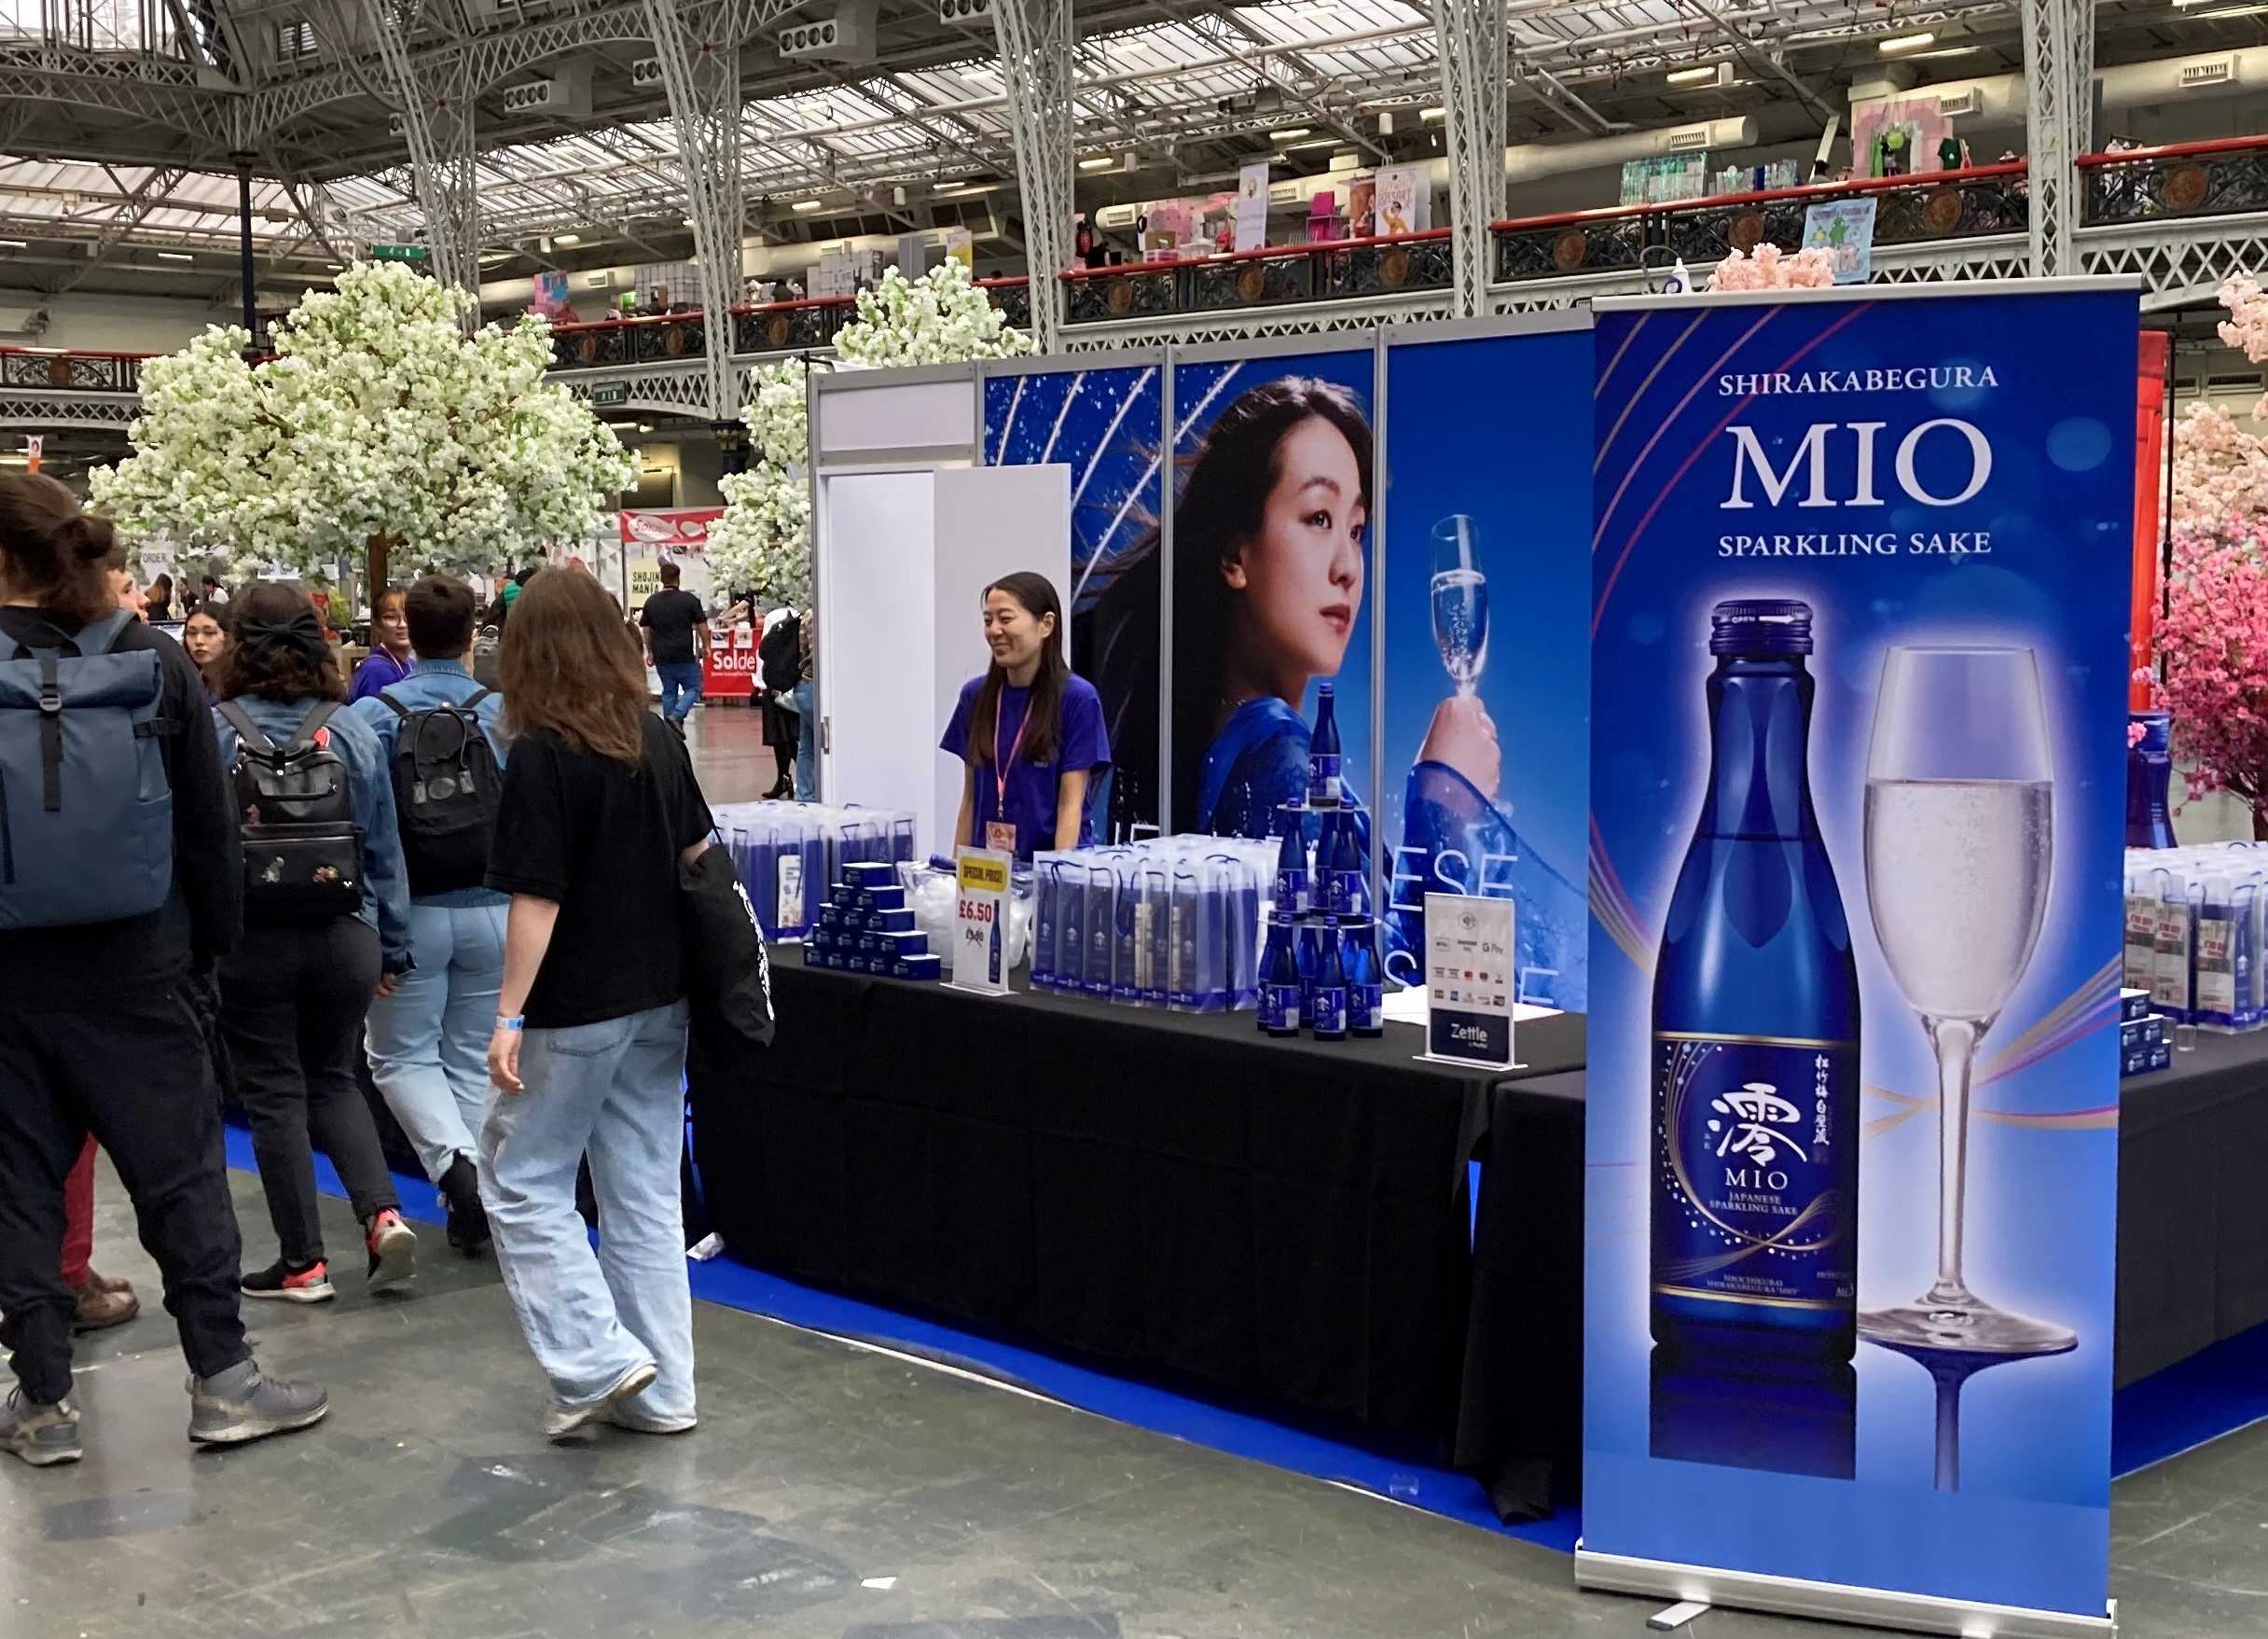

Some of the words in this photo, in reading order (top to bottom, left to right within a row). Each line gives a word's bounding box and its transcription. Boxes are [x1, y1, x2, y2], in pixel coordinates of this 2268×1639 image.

[1718, 366, 1998, 396] SHIRAKABEGURA
[1720, 418, 1993, 508] MIO
[1718, 534, 1898, 557] SPARKLING
[1909, 532, 1992, 555] SAKE
[632, 571, 659, 582] SHOJIN
[712, 649, 756, 670] Solde
[959, 899, 992, 923] £6.50
[1491, 943, 1504, 955] Pay
[1450, 1023, 1487, 1042] Zettle
[1708, 1082, 1807, 1167] 澪
[1724, 1167, 1789, 1190] MIO
[1708, 1200, 1769, 1214] SPARKLING
[1771, 1205, 1799, 1216] SAKE
[1728, 1191, 1781, 1205] JAPANESE
